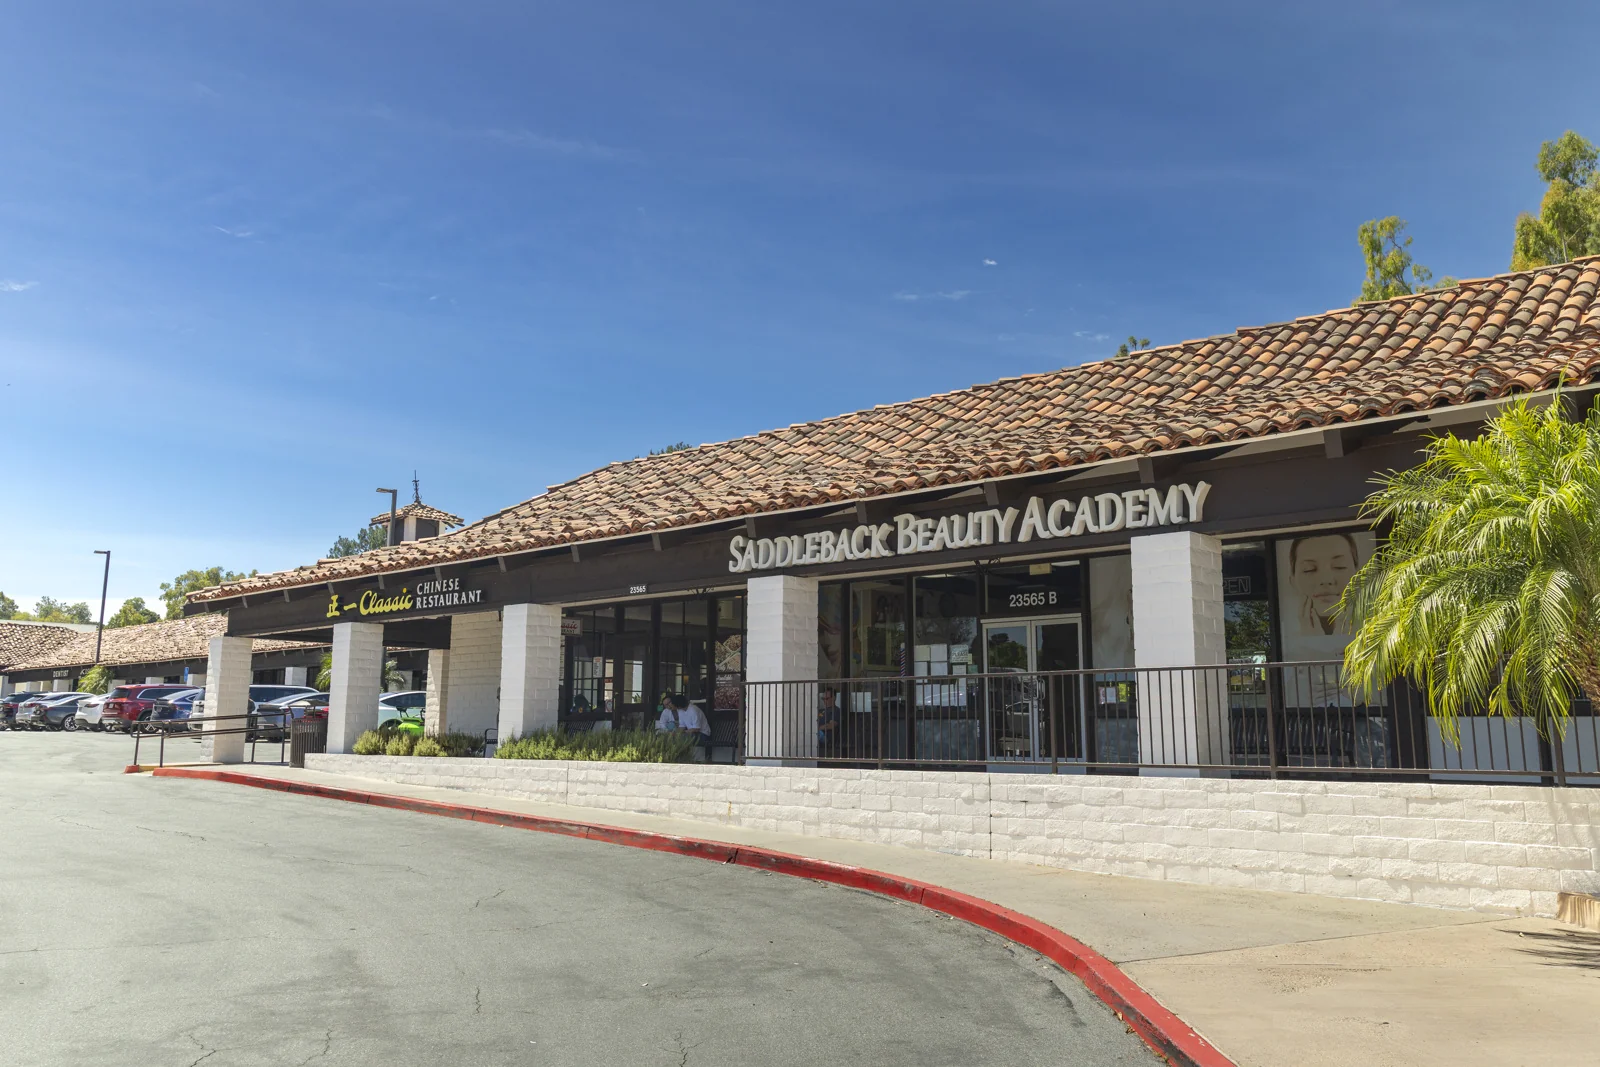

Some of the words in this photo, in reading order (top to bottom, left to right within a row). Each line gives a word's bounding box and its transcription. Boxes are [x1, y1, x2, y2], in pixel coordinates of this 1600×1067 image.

[728, 523, 895, 573] SADDLEBACK
[893, 507, 1019, 555] BEAUTY
[1018, 480, 1212, 543] ACADEMY
[416, 578, 460, 595] CHINESE
[629, 585, 646, 594] 23565
[1223, 578, 1249, 593] PEN
[359, 587, 414, 616] Classic
[416, 589, 482, 609] RESTAURANT
[1009, 592, 1045, 607] 23565
[1048, 591, 1057, 604] B
[52, 669, 69, 678] DENTIST
